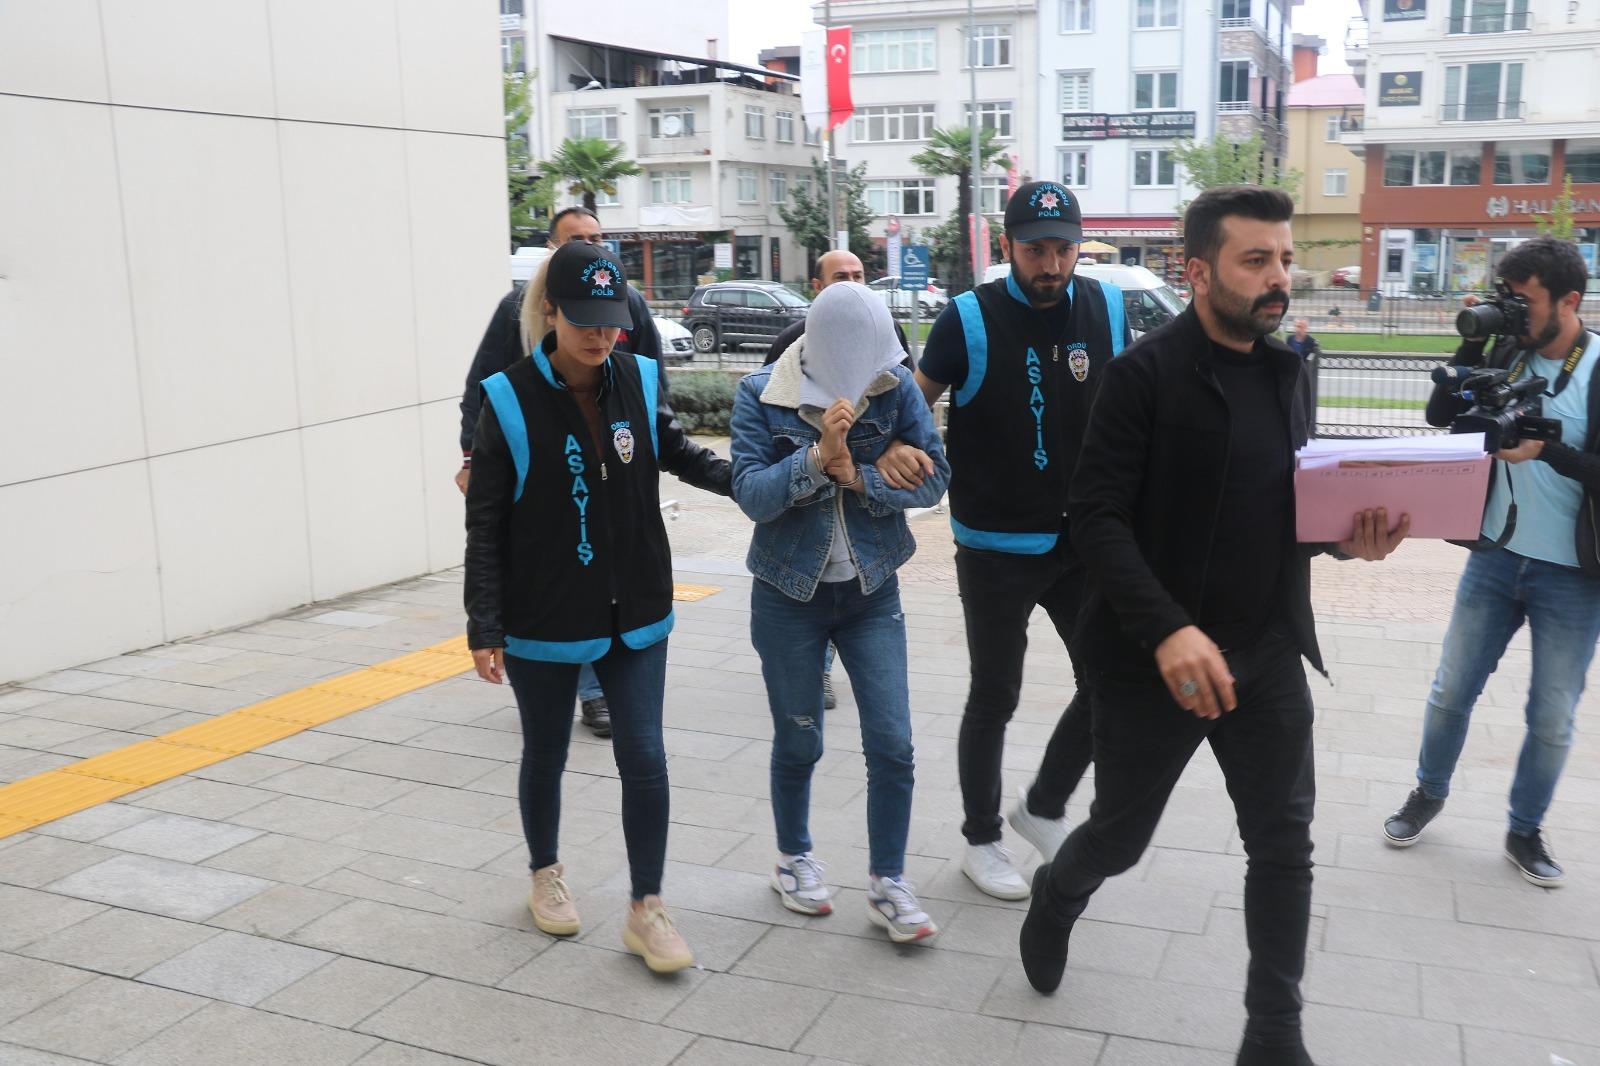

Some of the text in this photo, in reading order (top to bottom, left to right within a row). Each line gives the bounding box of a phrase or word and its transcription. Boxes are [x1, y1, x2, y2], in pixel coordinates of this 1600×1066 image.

[1038, 209, 1061, 217] POLİS
[580, 257, 622, 284] ASAYİŞ ORDU
[591, 287, 614, 296] POLİS
[1066, 342, 1087, 351] ORDU
[1562, 346, 1584, 373] Nikon
[1026, 347, 1049, 470] ASAYİŞ
[611, 421, 630, 431] ORDU
[564, 434, 594, 566] ASAYİŞ
